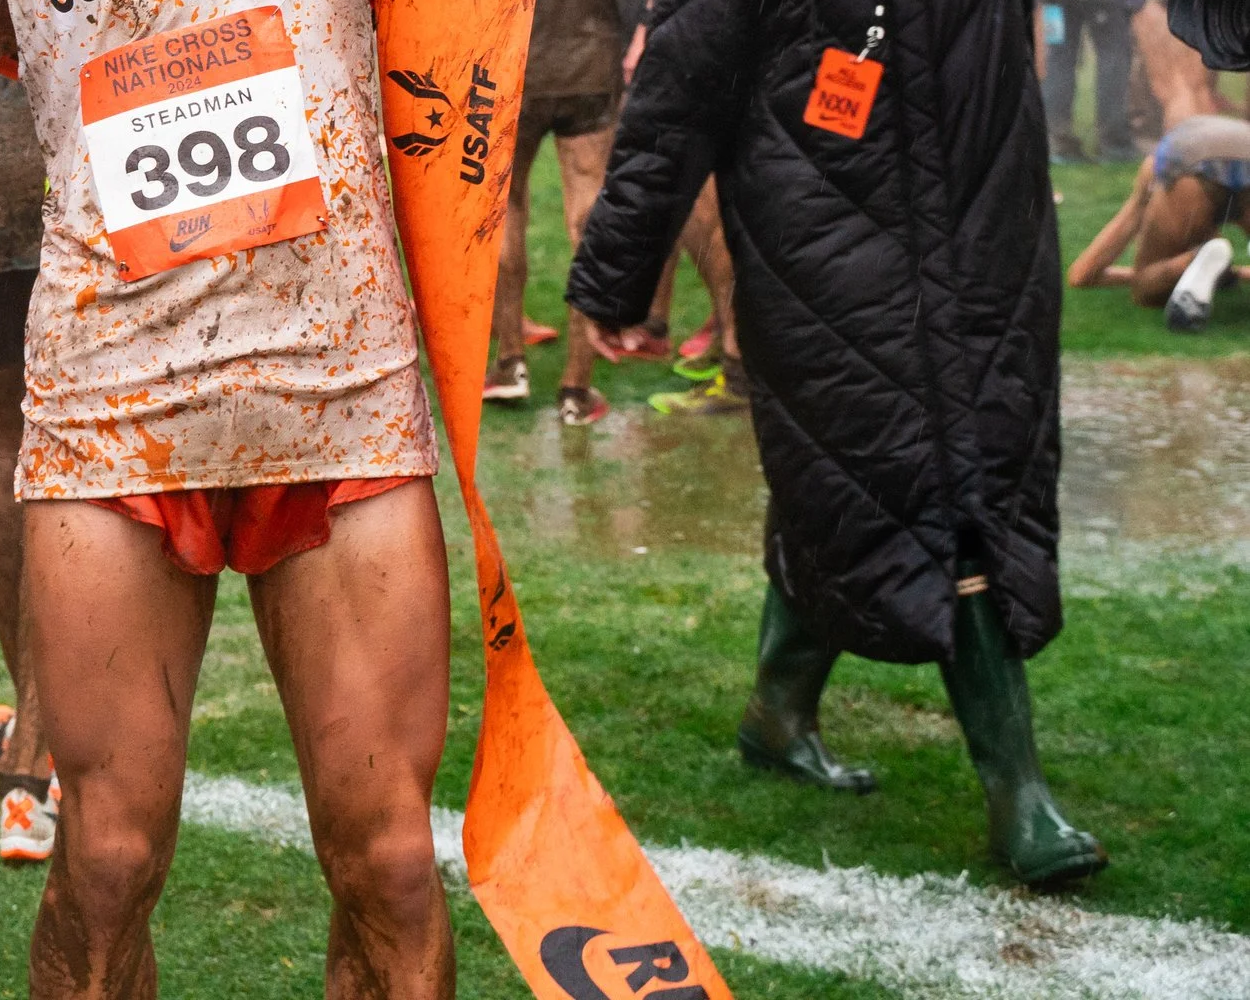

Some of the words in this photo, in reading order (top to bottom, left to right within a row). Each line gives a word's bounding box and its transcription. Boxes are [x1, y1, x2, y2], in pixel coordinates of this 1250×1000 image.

[104, 45, 158, 78] NIKE
[164, 18, 252, 58] CROSS
[112, 41, 252, 97] NATIONALS
[131, 87, 253, 133] STEADMAN
[168, 77, 202, 95] 2024
[459, 63, 497, 185] USATF
[125, 115, 291, 211] 398
[176, 213, 211, 237] RUN
